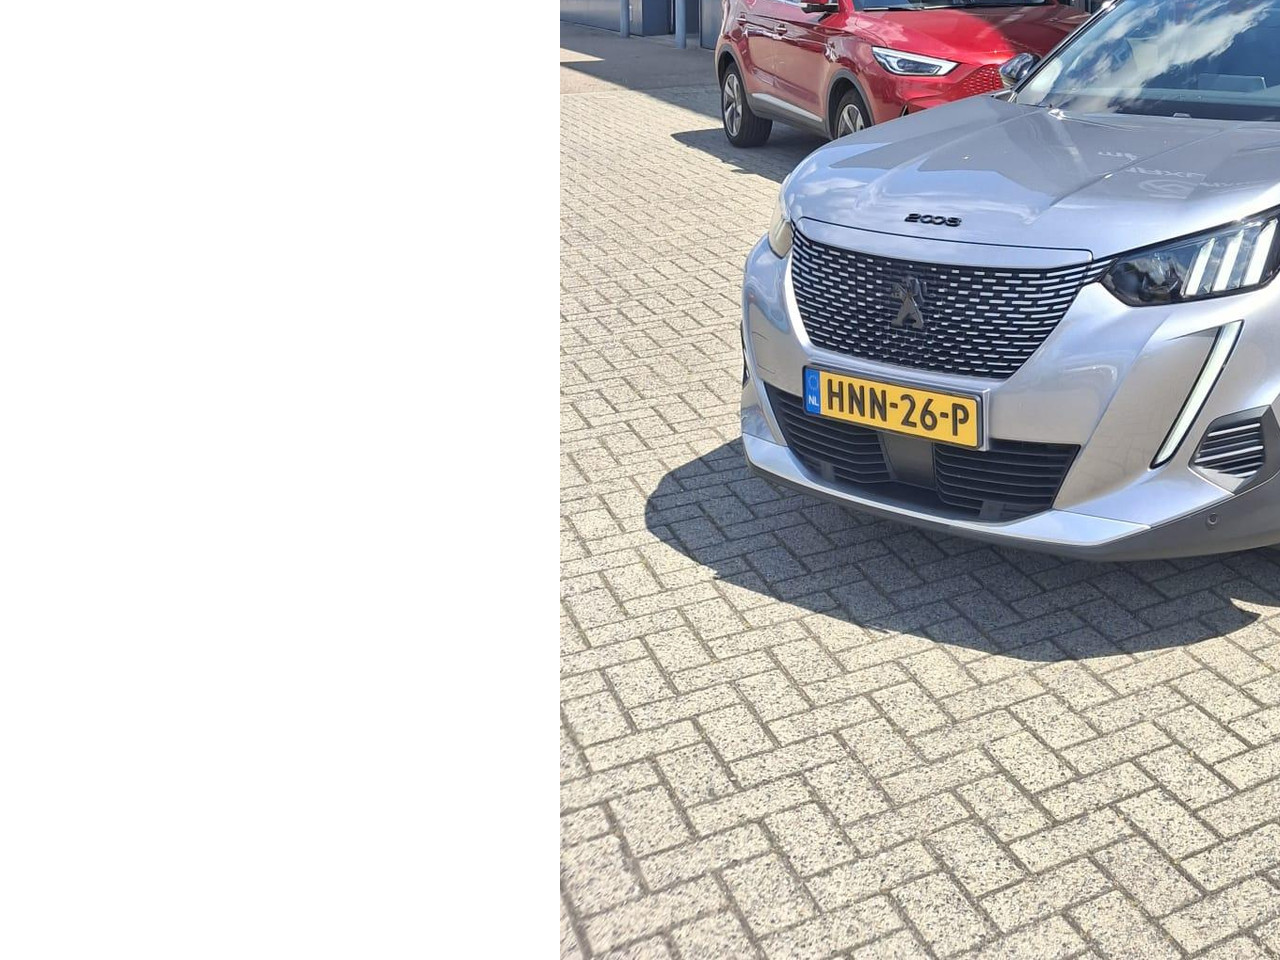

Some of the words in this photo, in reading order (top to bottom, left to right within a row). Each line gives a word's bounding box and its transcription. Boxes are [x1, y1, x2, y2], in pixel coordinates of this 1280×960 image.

[903, 213, 962, 228] 2008
[808, 396, 820, 407] NL
[827, 378, 970, 436] HNN-26-P
